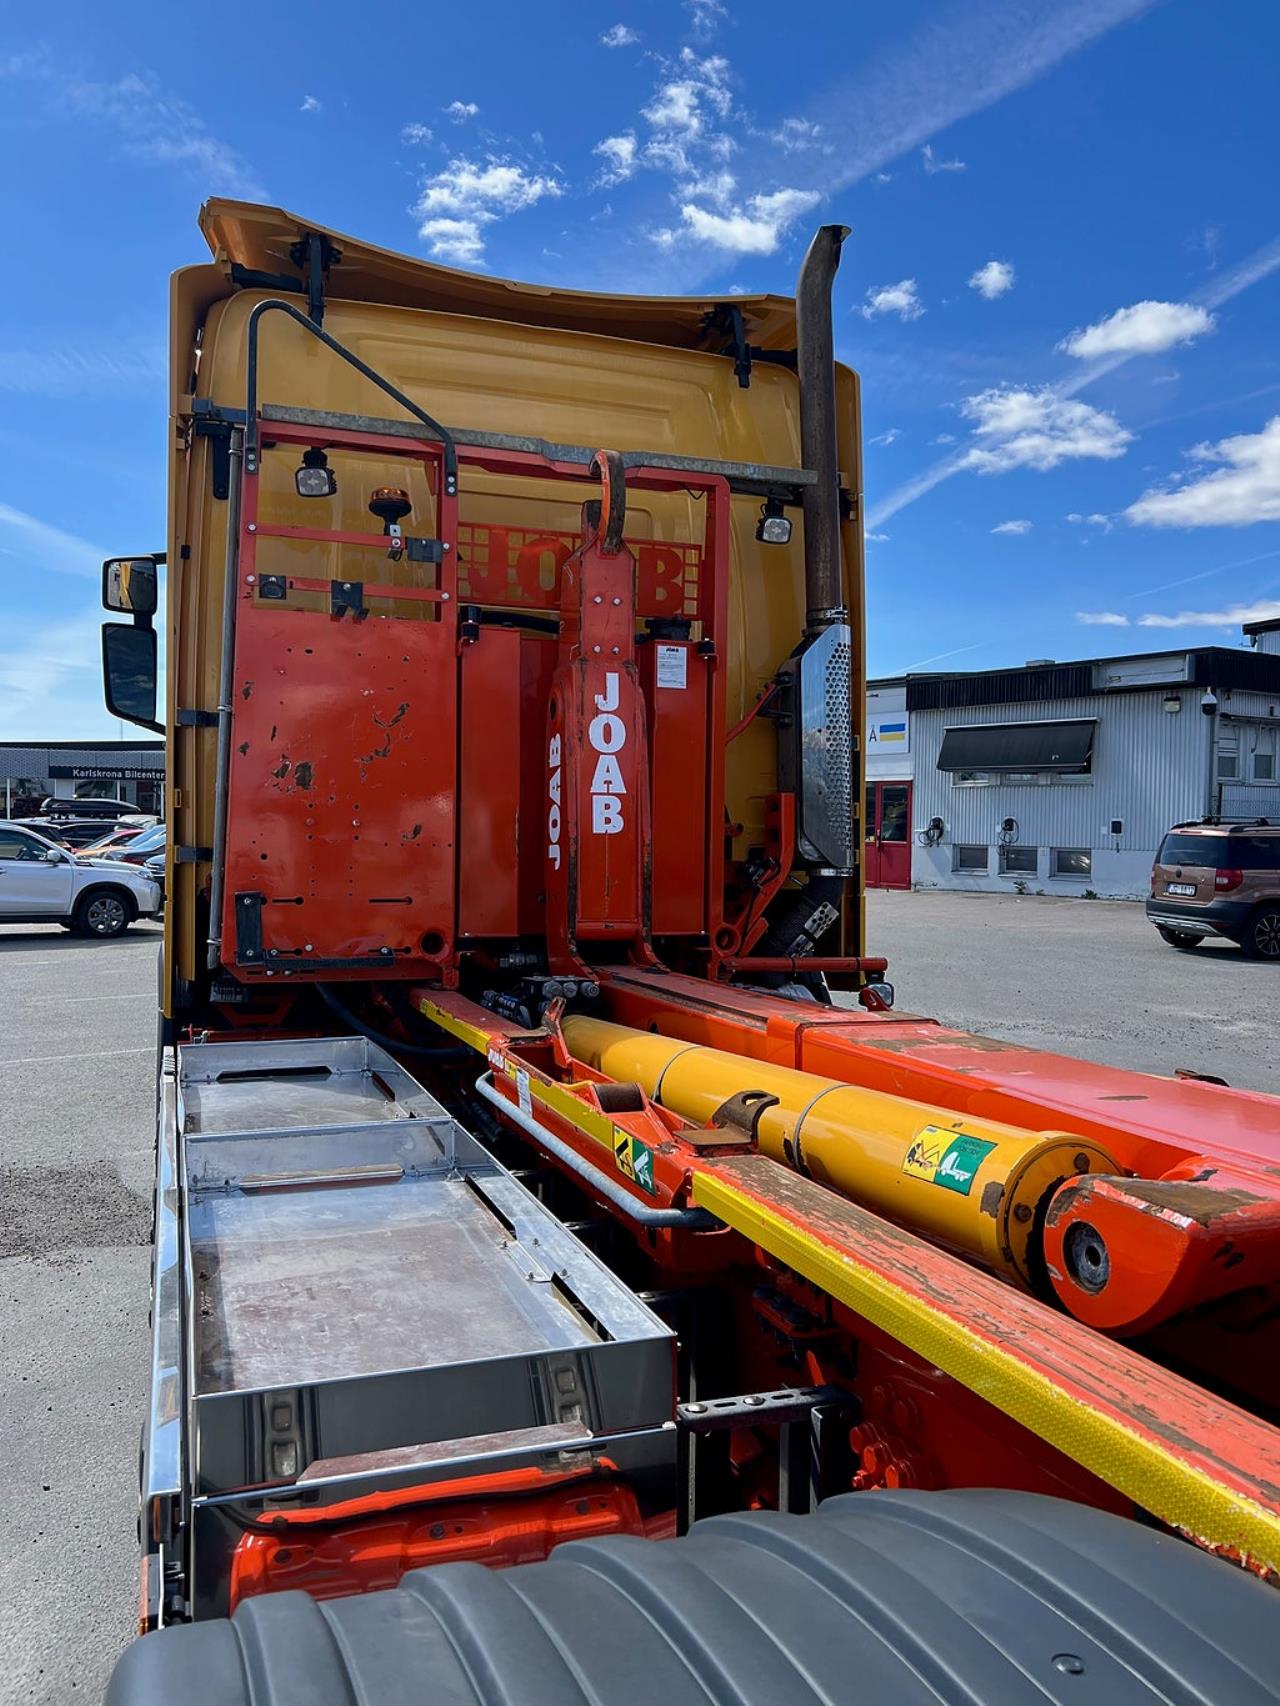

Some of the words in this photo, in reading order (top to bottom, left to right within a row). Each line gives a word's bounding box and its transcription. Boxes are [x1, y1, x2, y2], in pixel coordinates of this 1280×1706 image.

[467, 526, 684, 619] JOB
[73, 769, 122, 779] Karlskrona
[125, 770, 165, 780] Bilcenter
[548, 732, 561, 871] JOAB
[588, 672, 627, 834] JOAB
